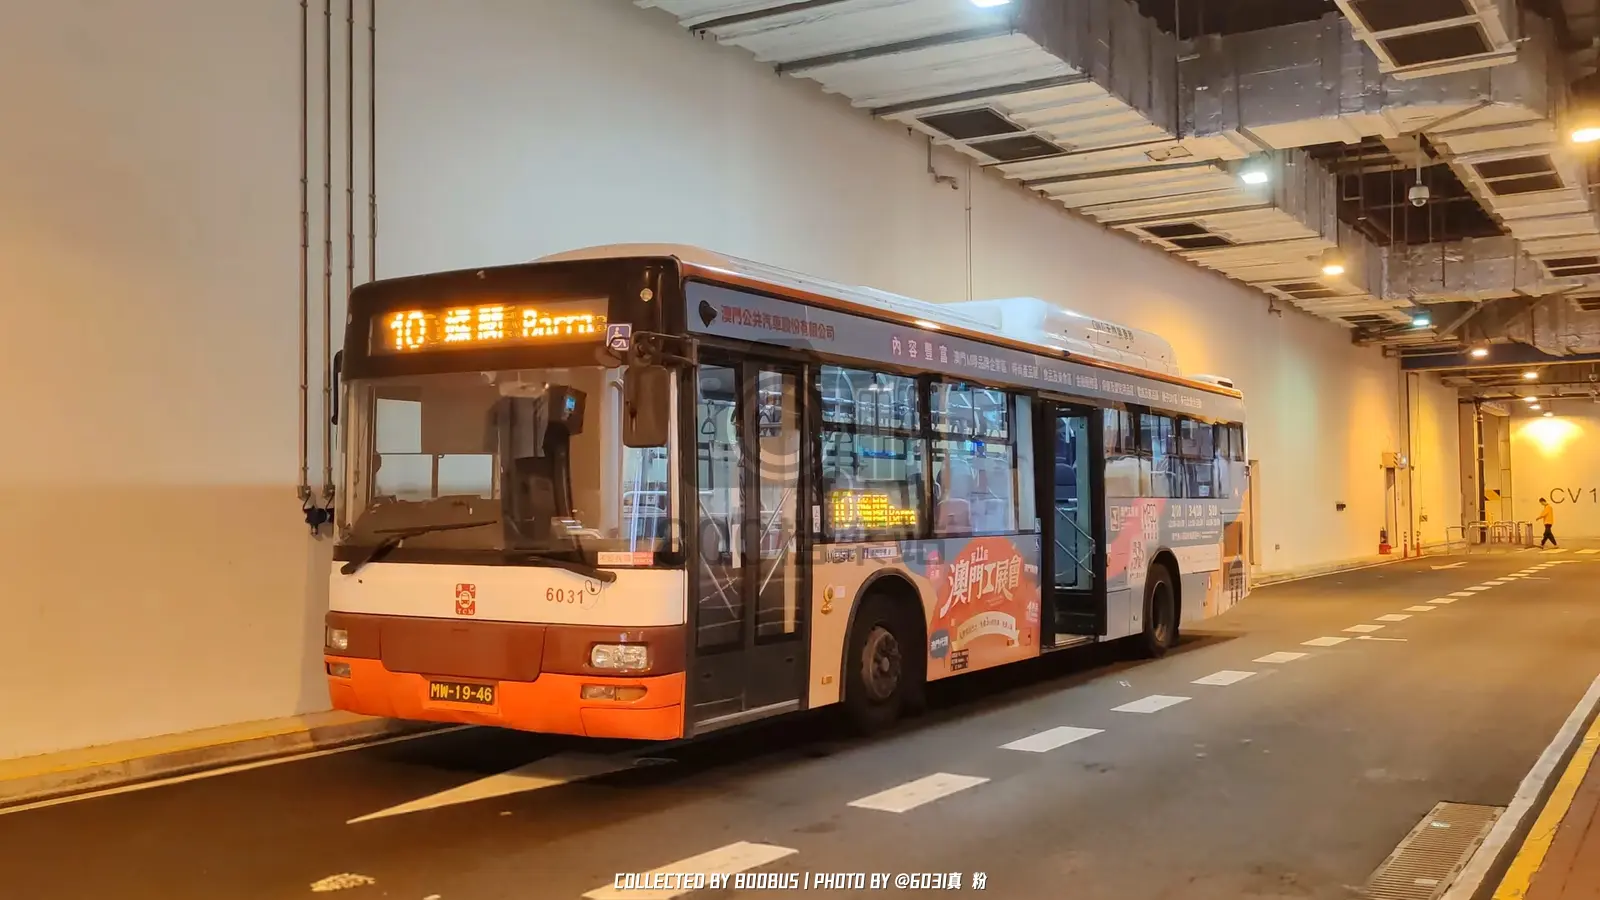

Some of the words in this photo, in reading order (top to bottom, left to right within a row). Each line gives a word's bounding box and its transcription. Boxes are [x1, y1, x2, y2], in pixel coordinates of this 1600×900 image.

[390, 310, 426, 350] 10
[1550, 487, 1582, 504] CV
[1589, 487, 1597, 504] 1
[546, 587, 584, 604] 6031
[939, 554, 1022, 619] 澳門工展會
[430, 683, 493, 702] MW-19-46
